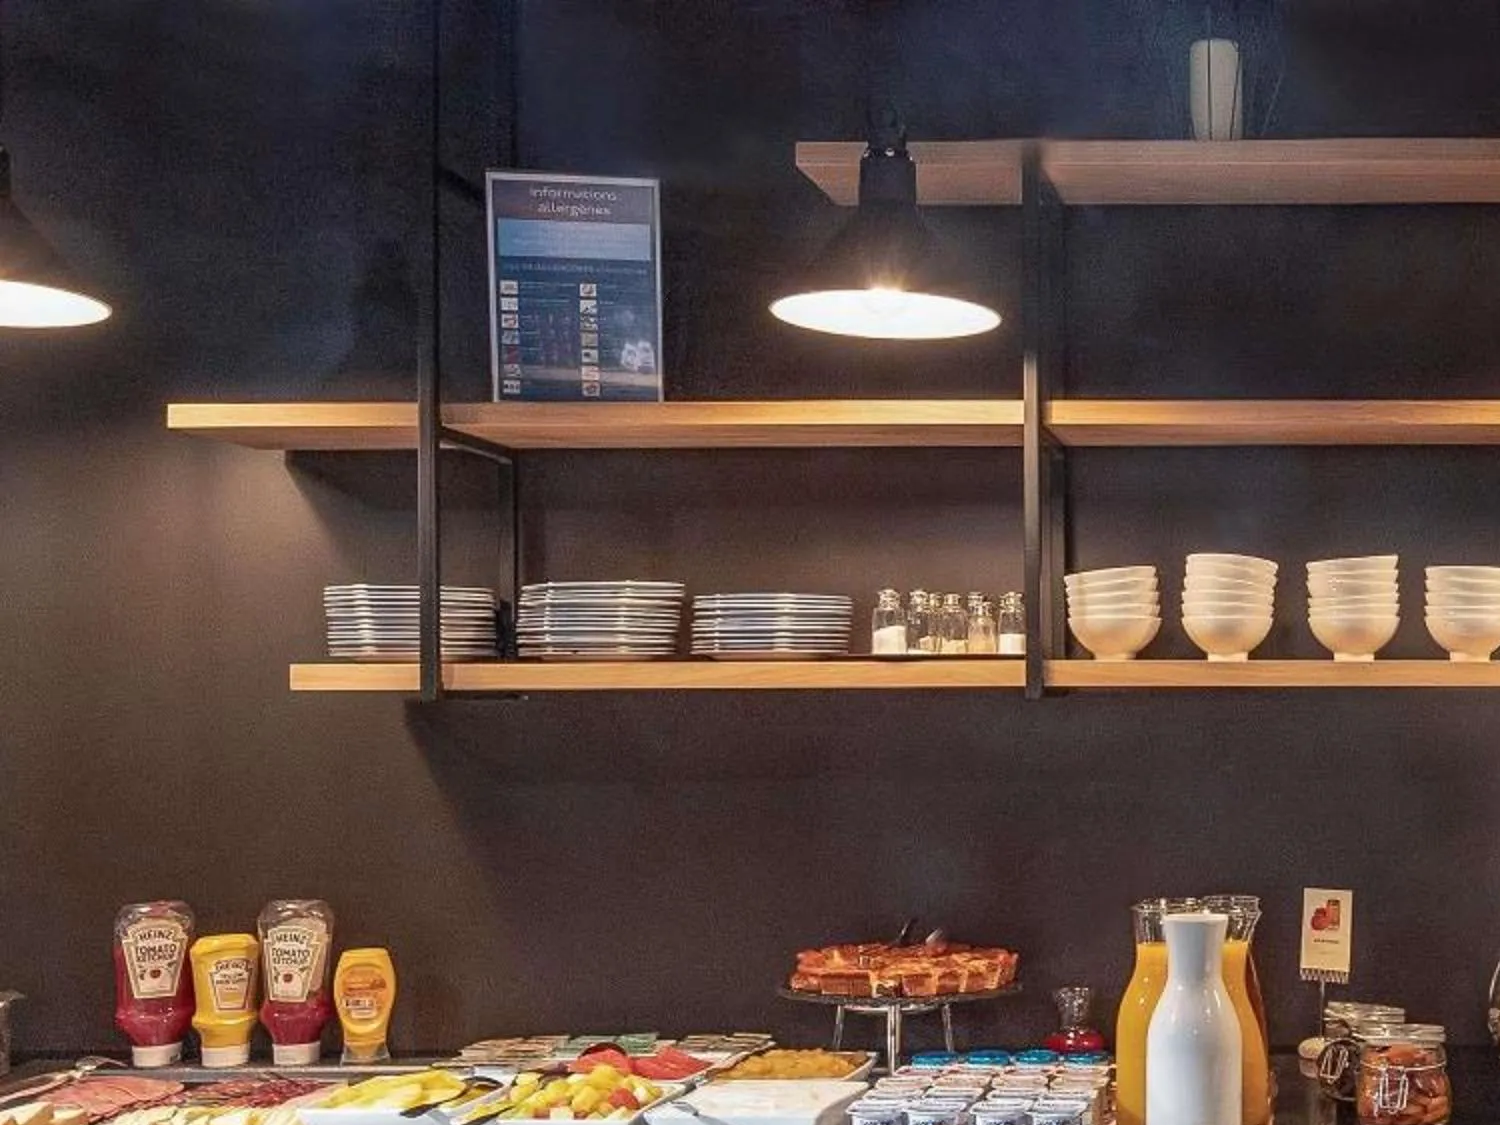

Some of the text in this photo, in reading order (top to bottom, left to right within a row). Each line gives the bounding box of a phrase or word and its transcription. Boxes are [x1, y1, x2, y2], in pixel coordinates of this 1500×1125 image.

[138, 930, 174, 941] HEINZ
[275, 932, 307, 945] HEINZ
[135, 943, 177, 954] TOMATO
[271, 948, 310, 958] TOMATO
